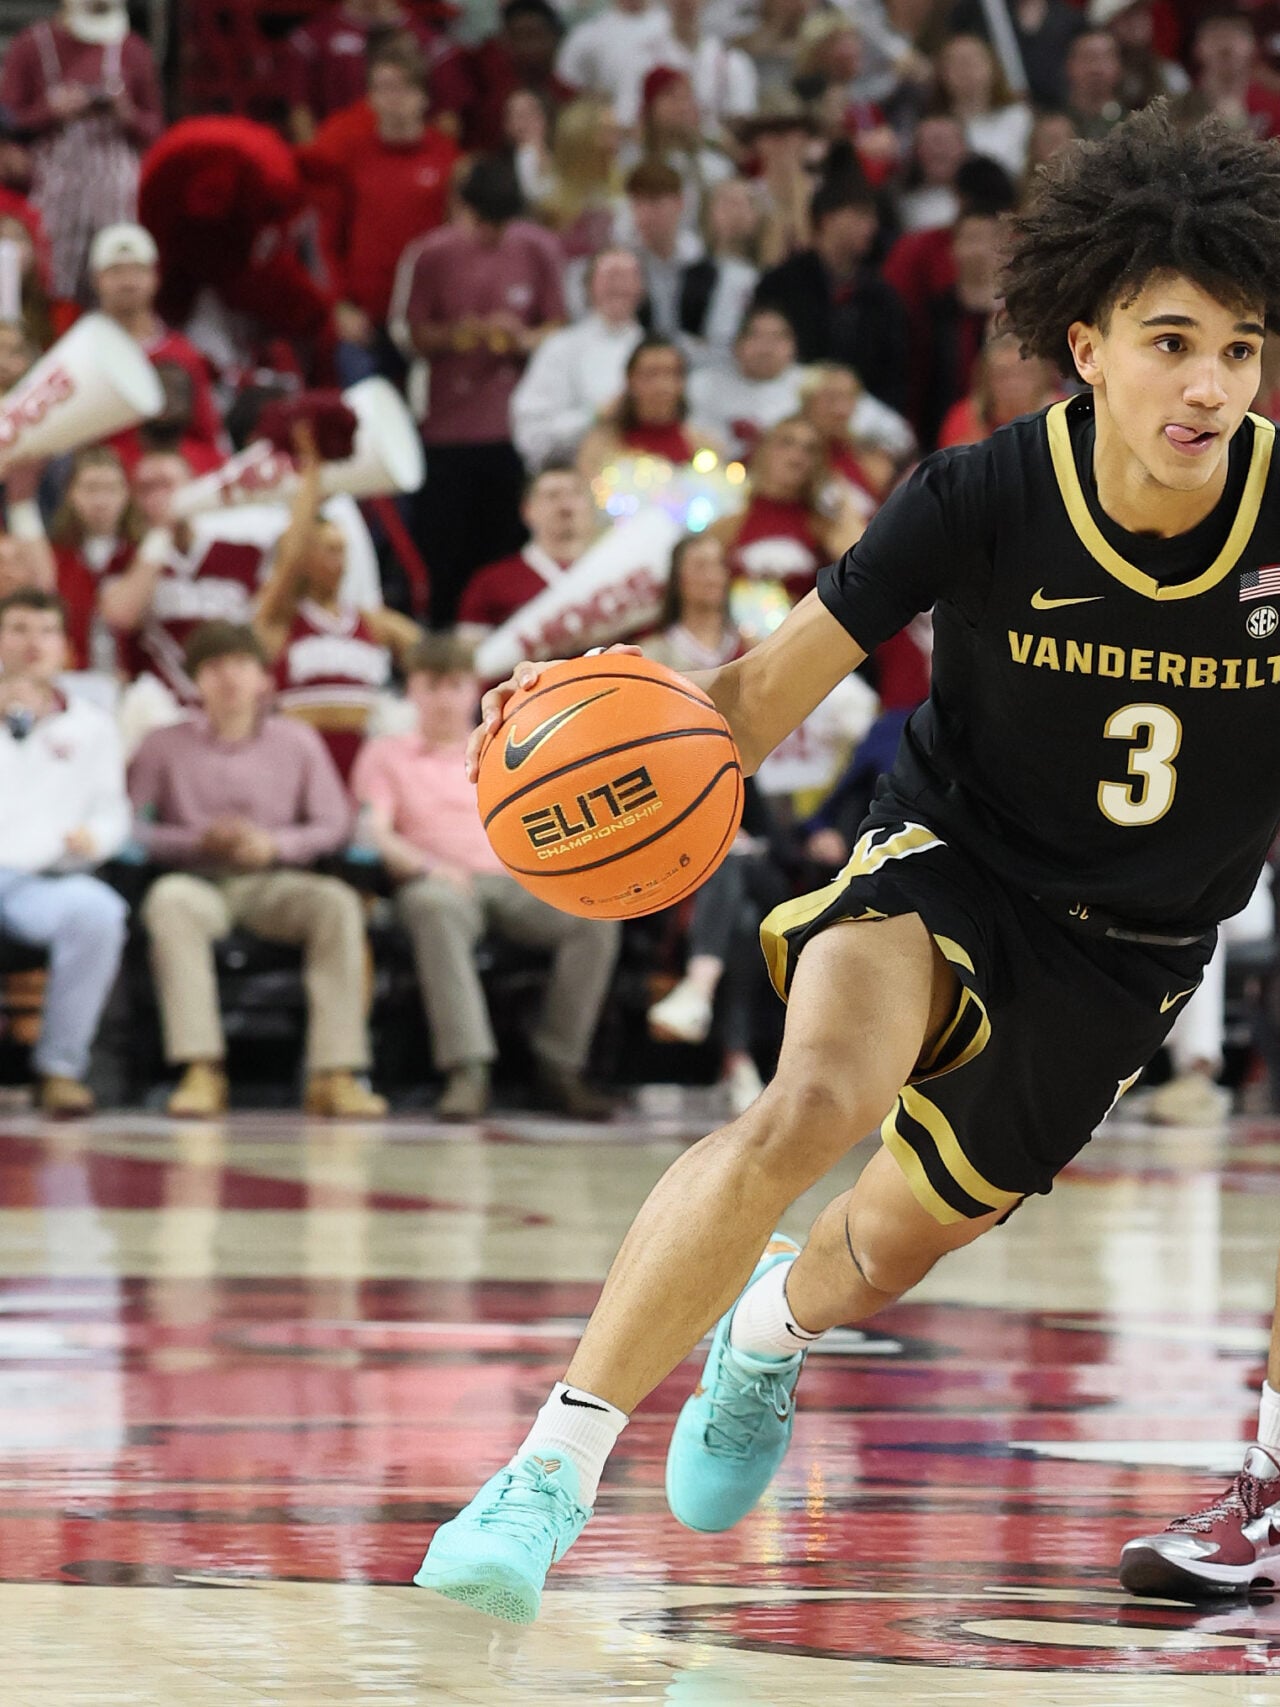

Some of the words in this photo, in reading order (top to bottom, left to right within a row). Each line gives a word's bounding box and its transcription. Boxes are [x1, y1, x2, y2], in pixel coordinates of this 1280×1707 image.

[1249, 611, 1277, 636] SEC
[1097, 702, 1184, 827] 3
[520, 765, 659, 848] ELITE
[536, 800, 664, 861] CHAMPIONSHIP
